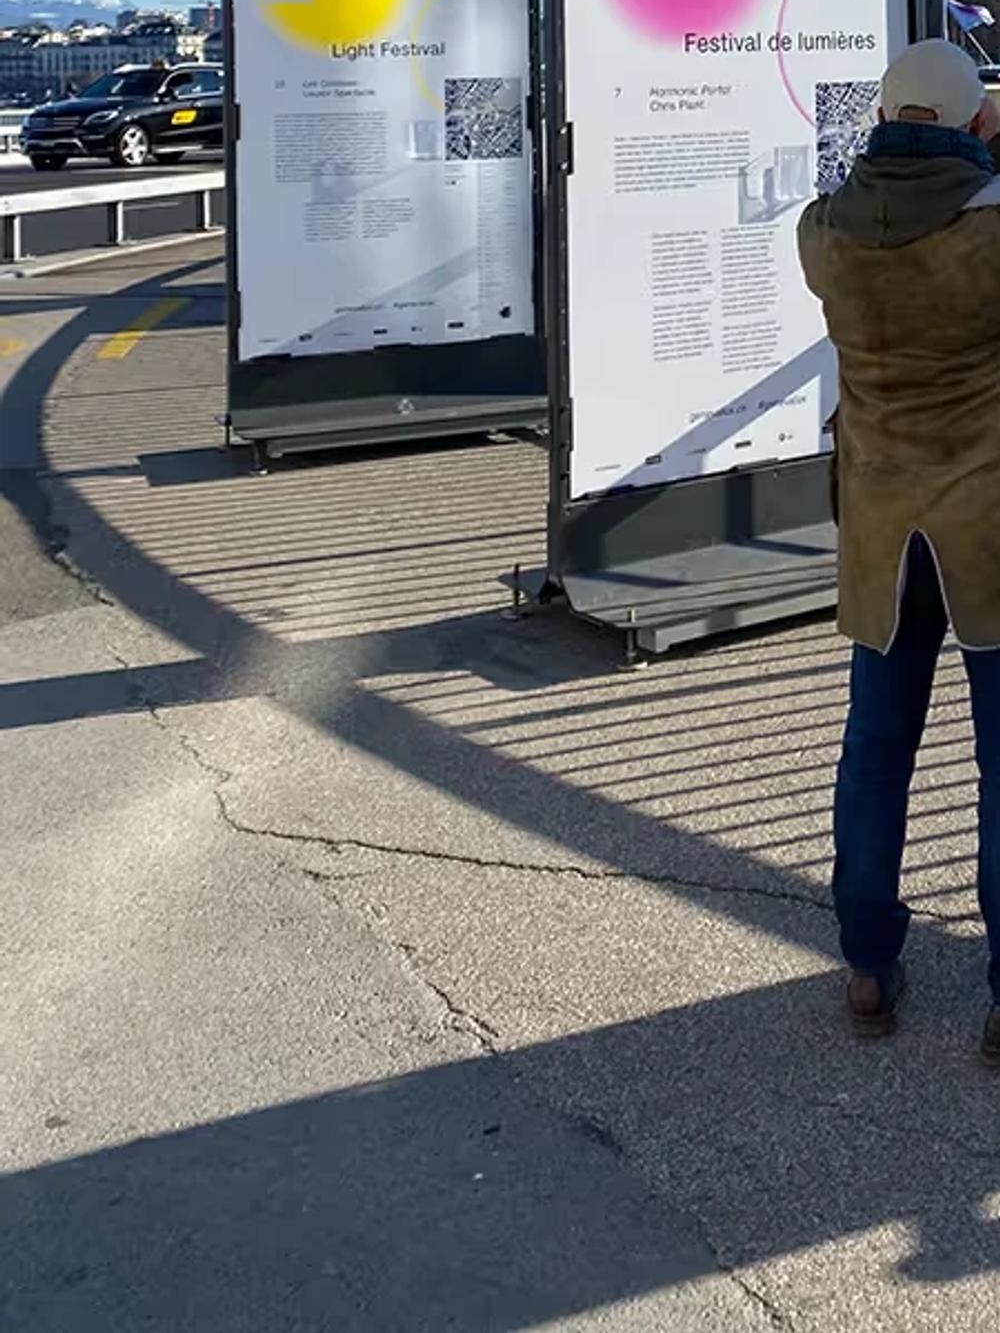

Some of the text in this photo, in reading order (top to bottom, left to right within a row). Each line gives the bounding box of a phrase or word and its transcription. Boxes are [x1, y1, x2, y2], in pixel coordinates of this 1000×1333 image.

[331, 42, 446, 63] Light Festival
[684, 30, 876, 54] Festival de lumières
